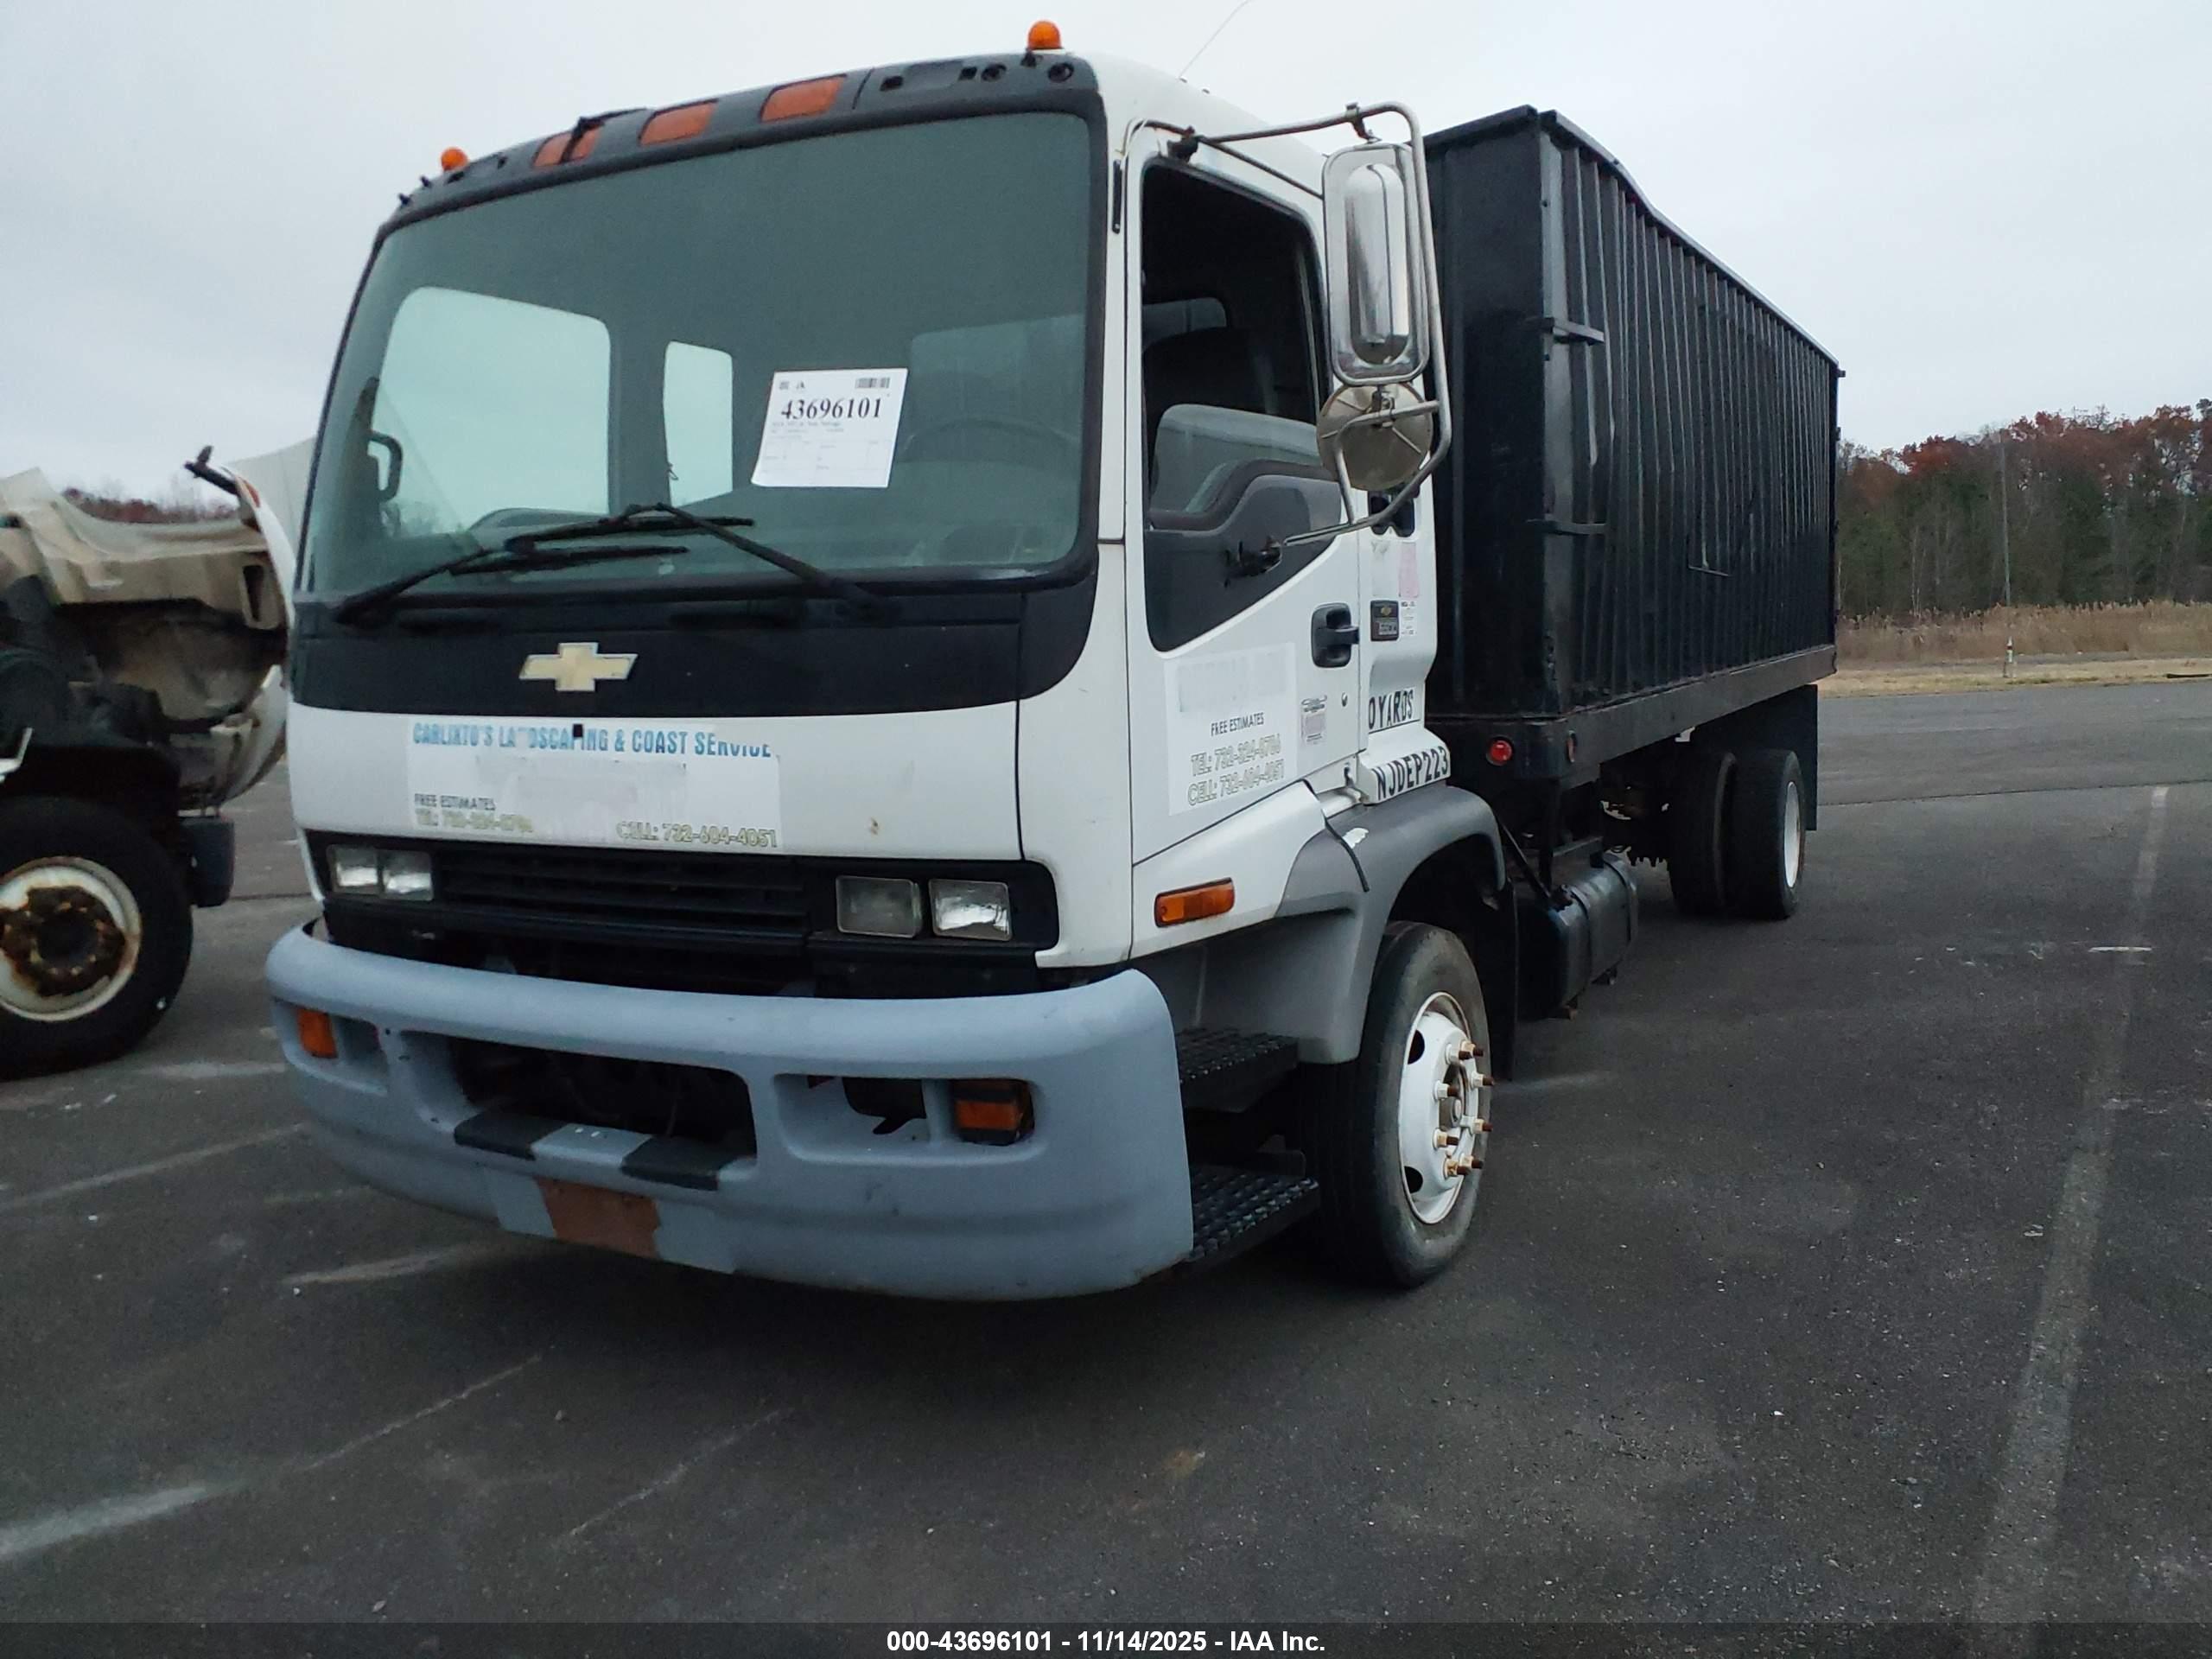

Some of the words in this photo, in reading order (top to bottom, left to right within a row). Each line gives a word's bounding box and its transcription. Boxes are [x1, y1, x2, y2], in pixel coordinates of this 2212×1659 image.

[781, 397, 882, 420] 43696101
[1211, 720, 1228, 737] FREE
[1229, 711, 1264, 733] ESTIMATES
[498, 726, 608, 751] LADSCAING
[614, 729, 625, 752] &
[632, 729, 689, 754] COAST
[1370, 746, 1448, 801] NJDEP223
[662, 823, 779, 848] 732-604-4051
